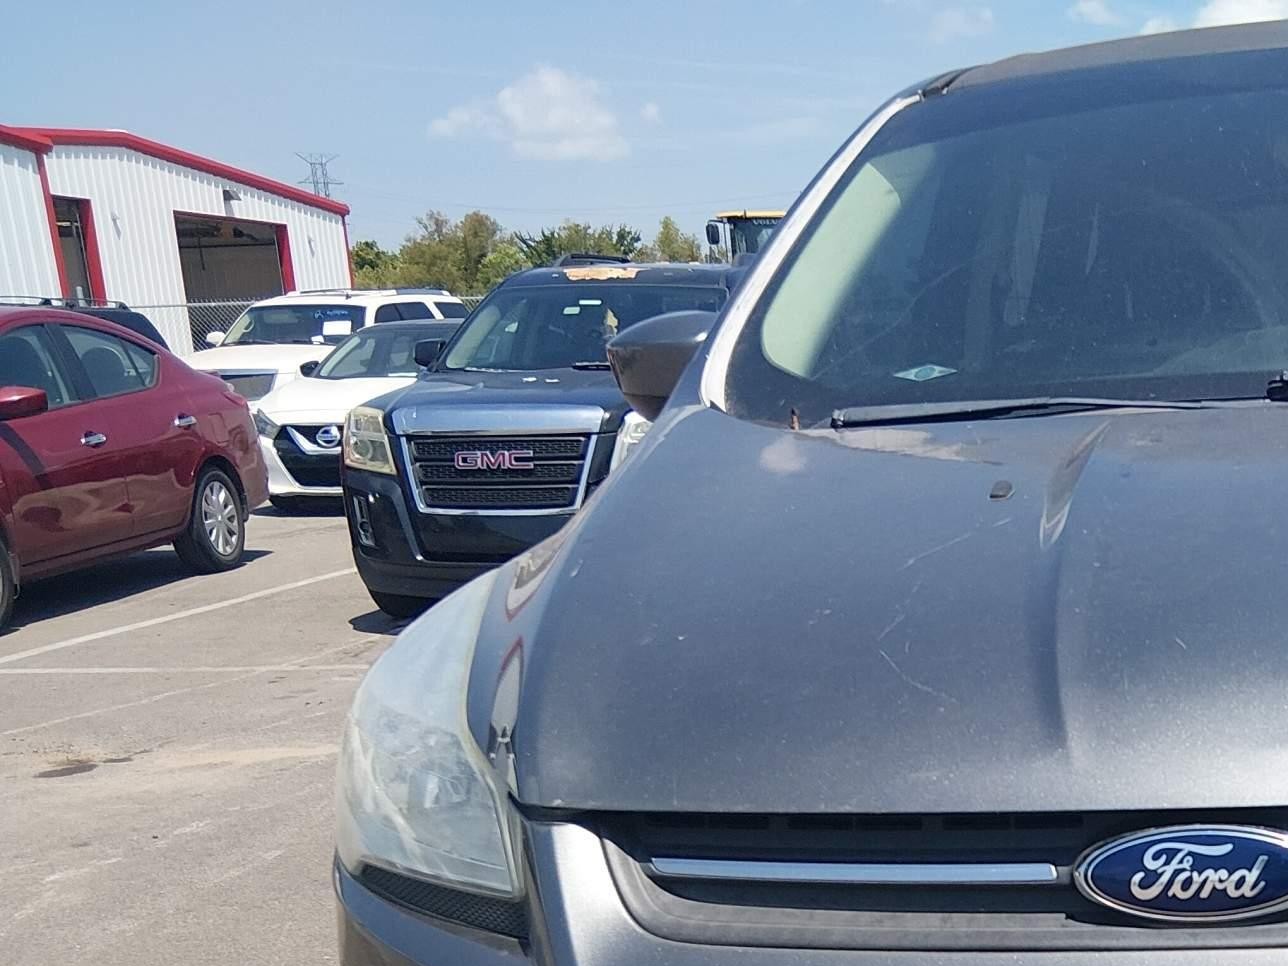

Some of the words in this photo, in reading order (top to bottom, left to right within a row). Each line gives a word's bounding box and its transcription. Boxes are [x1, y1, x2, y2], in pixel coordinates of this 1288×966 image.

[752, 218, 778, 226] VOLV
[454, 450, 535, 470] GMC
[1129, 841, 1269, 901] Ford
